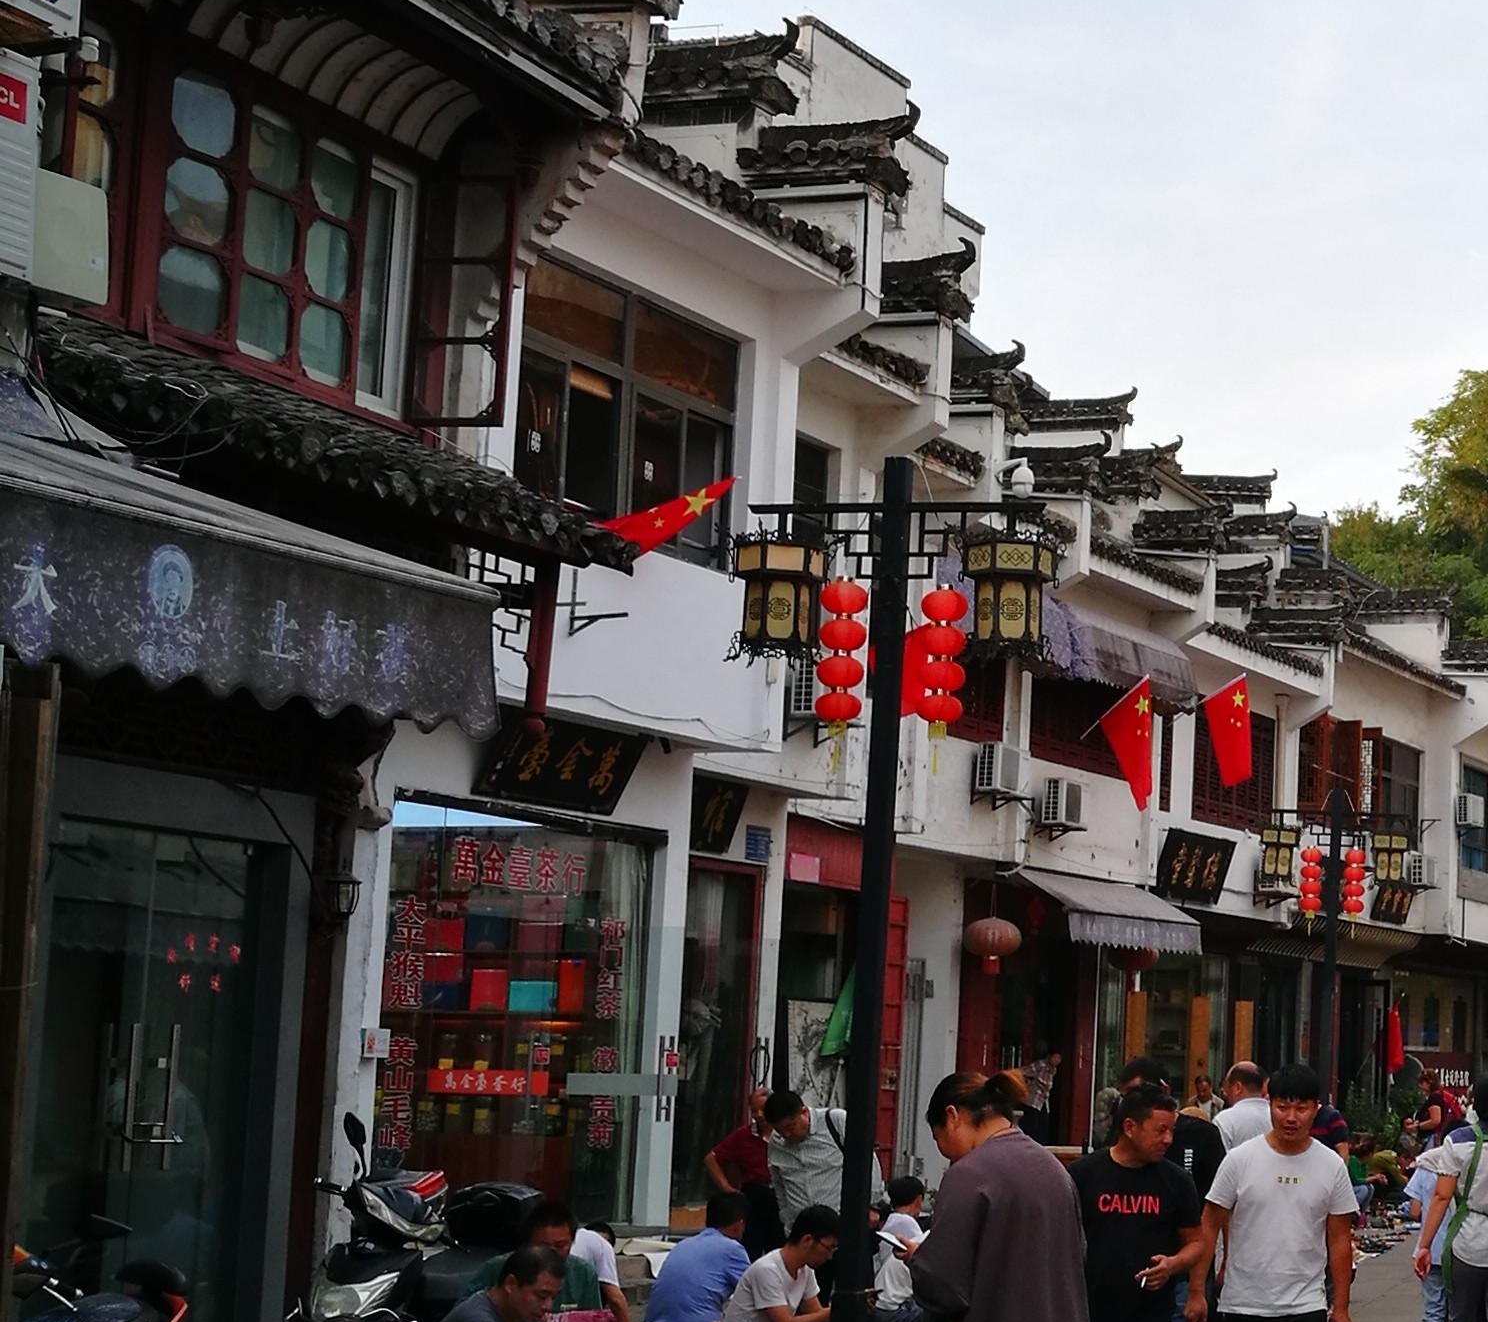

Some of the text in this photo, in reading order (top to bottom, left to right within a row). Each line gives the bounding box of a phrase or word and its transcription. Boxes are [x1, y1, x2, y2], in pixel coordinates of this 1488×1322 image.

[389, 894, 427, 1009] 太平猴魁
[595, 916, 627, 1020] 祁门红茶
[377, 1036, 419, 1152] 黄山毛峰
[586, 1045, 619, 1149] 徽贡菊
[1097, 1192, 1160, 1215] CALVIN
